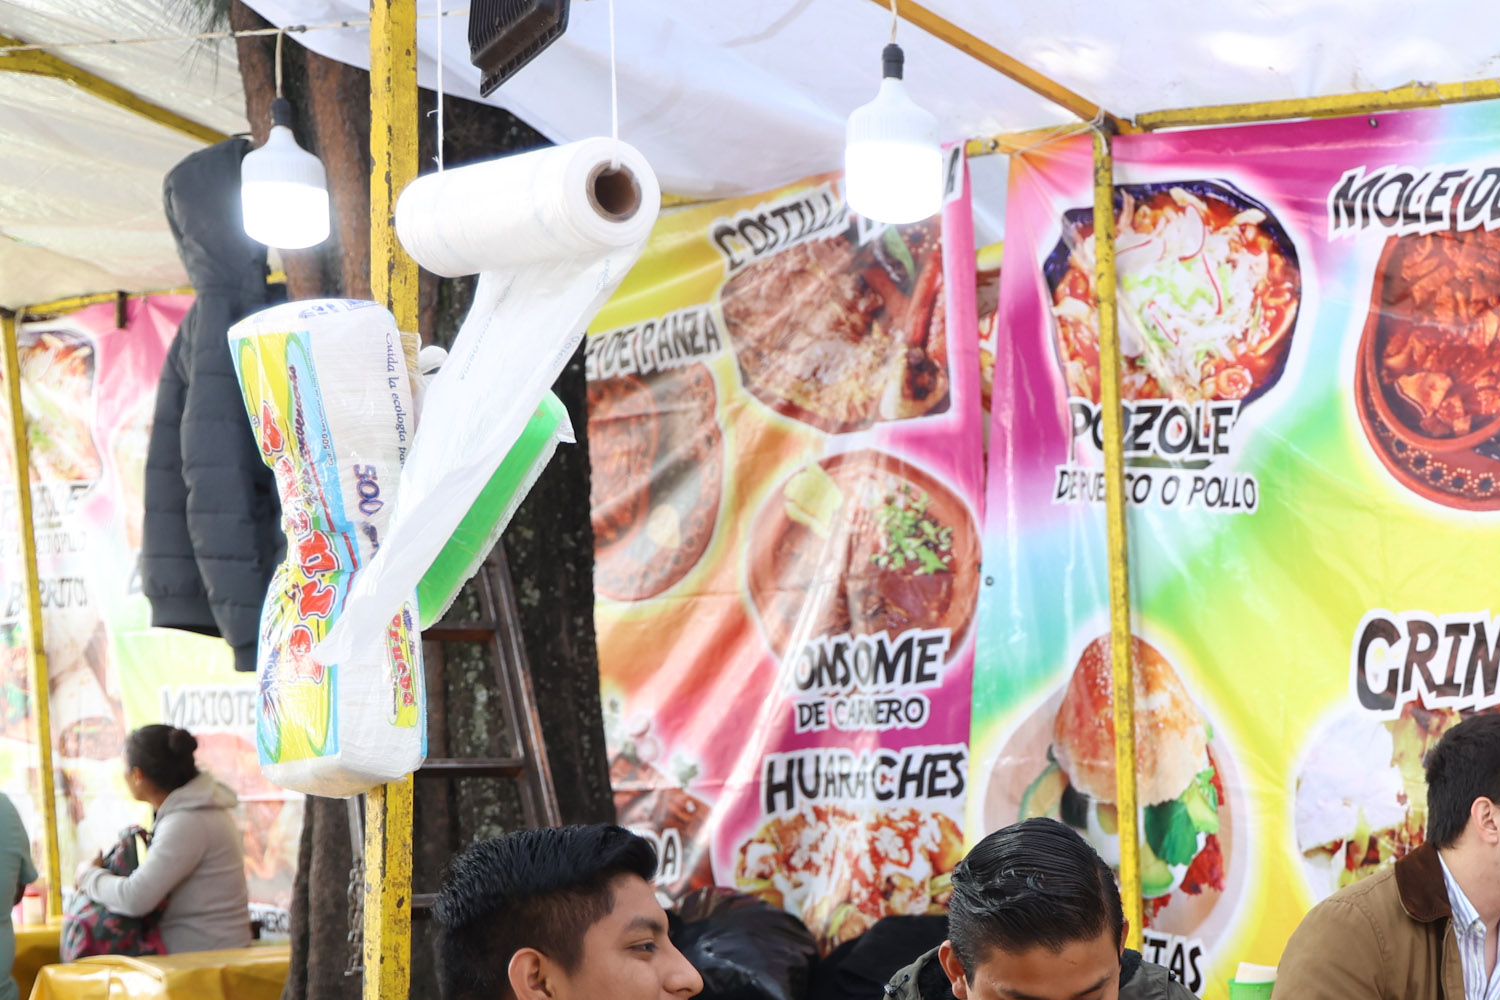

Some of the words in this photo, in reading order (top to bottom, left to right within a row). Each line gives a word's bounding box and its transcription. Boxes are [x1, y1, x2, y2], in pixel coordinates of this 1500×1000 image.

[1332, 168, 1468, 230] MOLE
[386, 332, 399, 373] Cuida
[641, 310, 721, 364] PANZA
[388, 376, 400, 389] la
[321, 433, 330, 450] 500
[353, 463, 384, 515] 500
[1079, 472, 1153, 504] PUECO
[1161, 475, 1181, 505] O
[1187, 476, 1257, 509] POLLO
[795, 636, 944, 690] ONSOME
[797, 702, 826, 728] DE
[834, 697, 924, 727] CARNERO
[766, 750, 967, 814] HUARACHES
[1143, 935, 1203, 993] TAS
